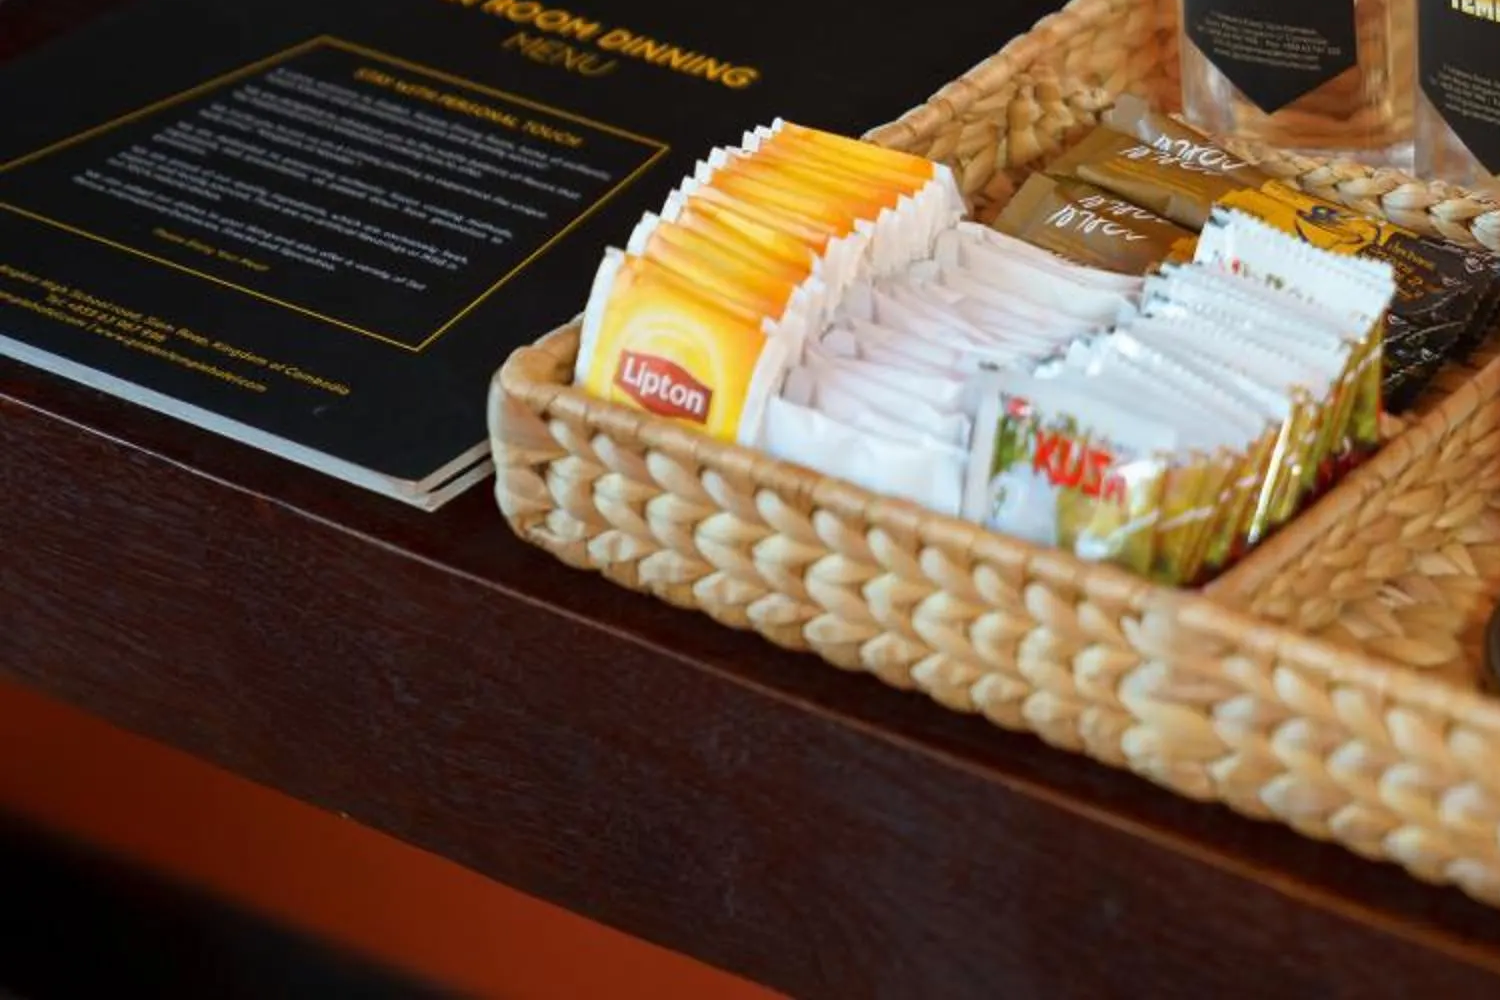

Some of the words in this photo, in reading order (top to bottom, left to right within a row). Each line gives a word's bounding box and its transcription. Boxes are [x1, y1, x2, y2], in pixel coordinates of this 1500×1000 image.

[502, 30, 620, 76] MENU
[597, 27, 760, 89] DINNING
[439, 91, 519, 129] PERSONAL
[622, 356, 705, 414] Lipton
